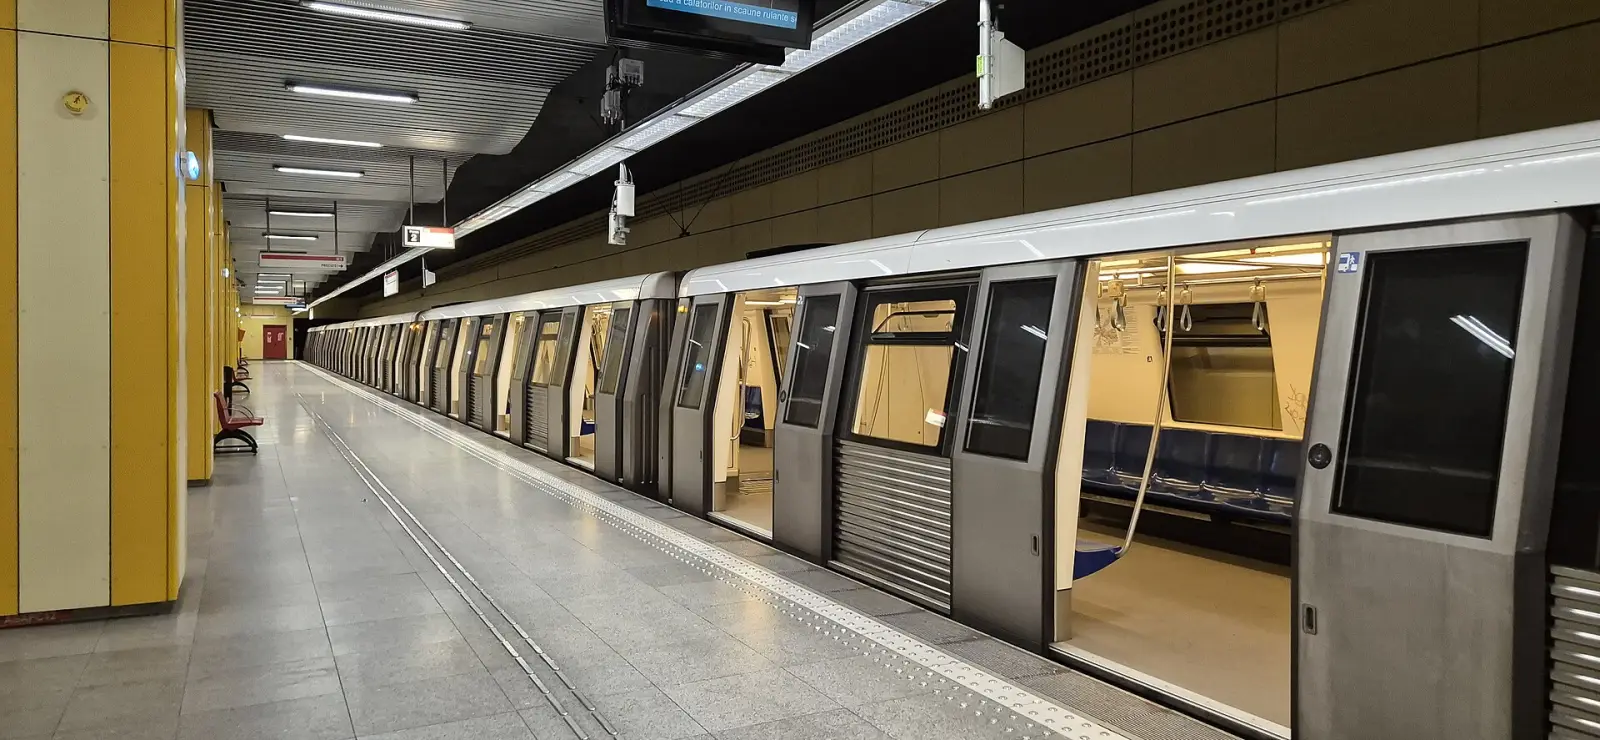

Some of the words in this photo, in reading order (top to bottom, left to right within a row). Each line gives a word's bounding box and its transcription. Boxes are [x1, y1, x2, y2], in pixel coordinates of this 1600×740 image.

[683, 0, 723, 11] calatorilor
[724, 3, 732, 12] in
[733, 6, 761, 17] scaune
[762, 9, 789, 22] rulante
[410, 233, 418, 242] 2
